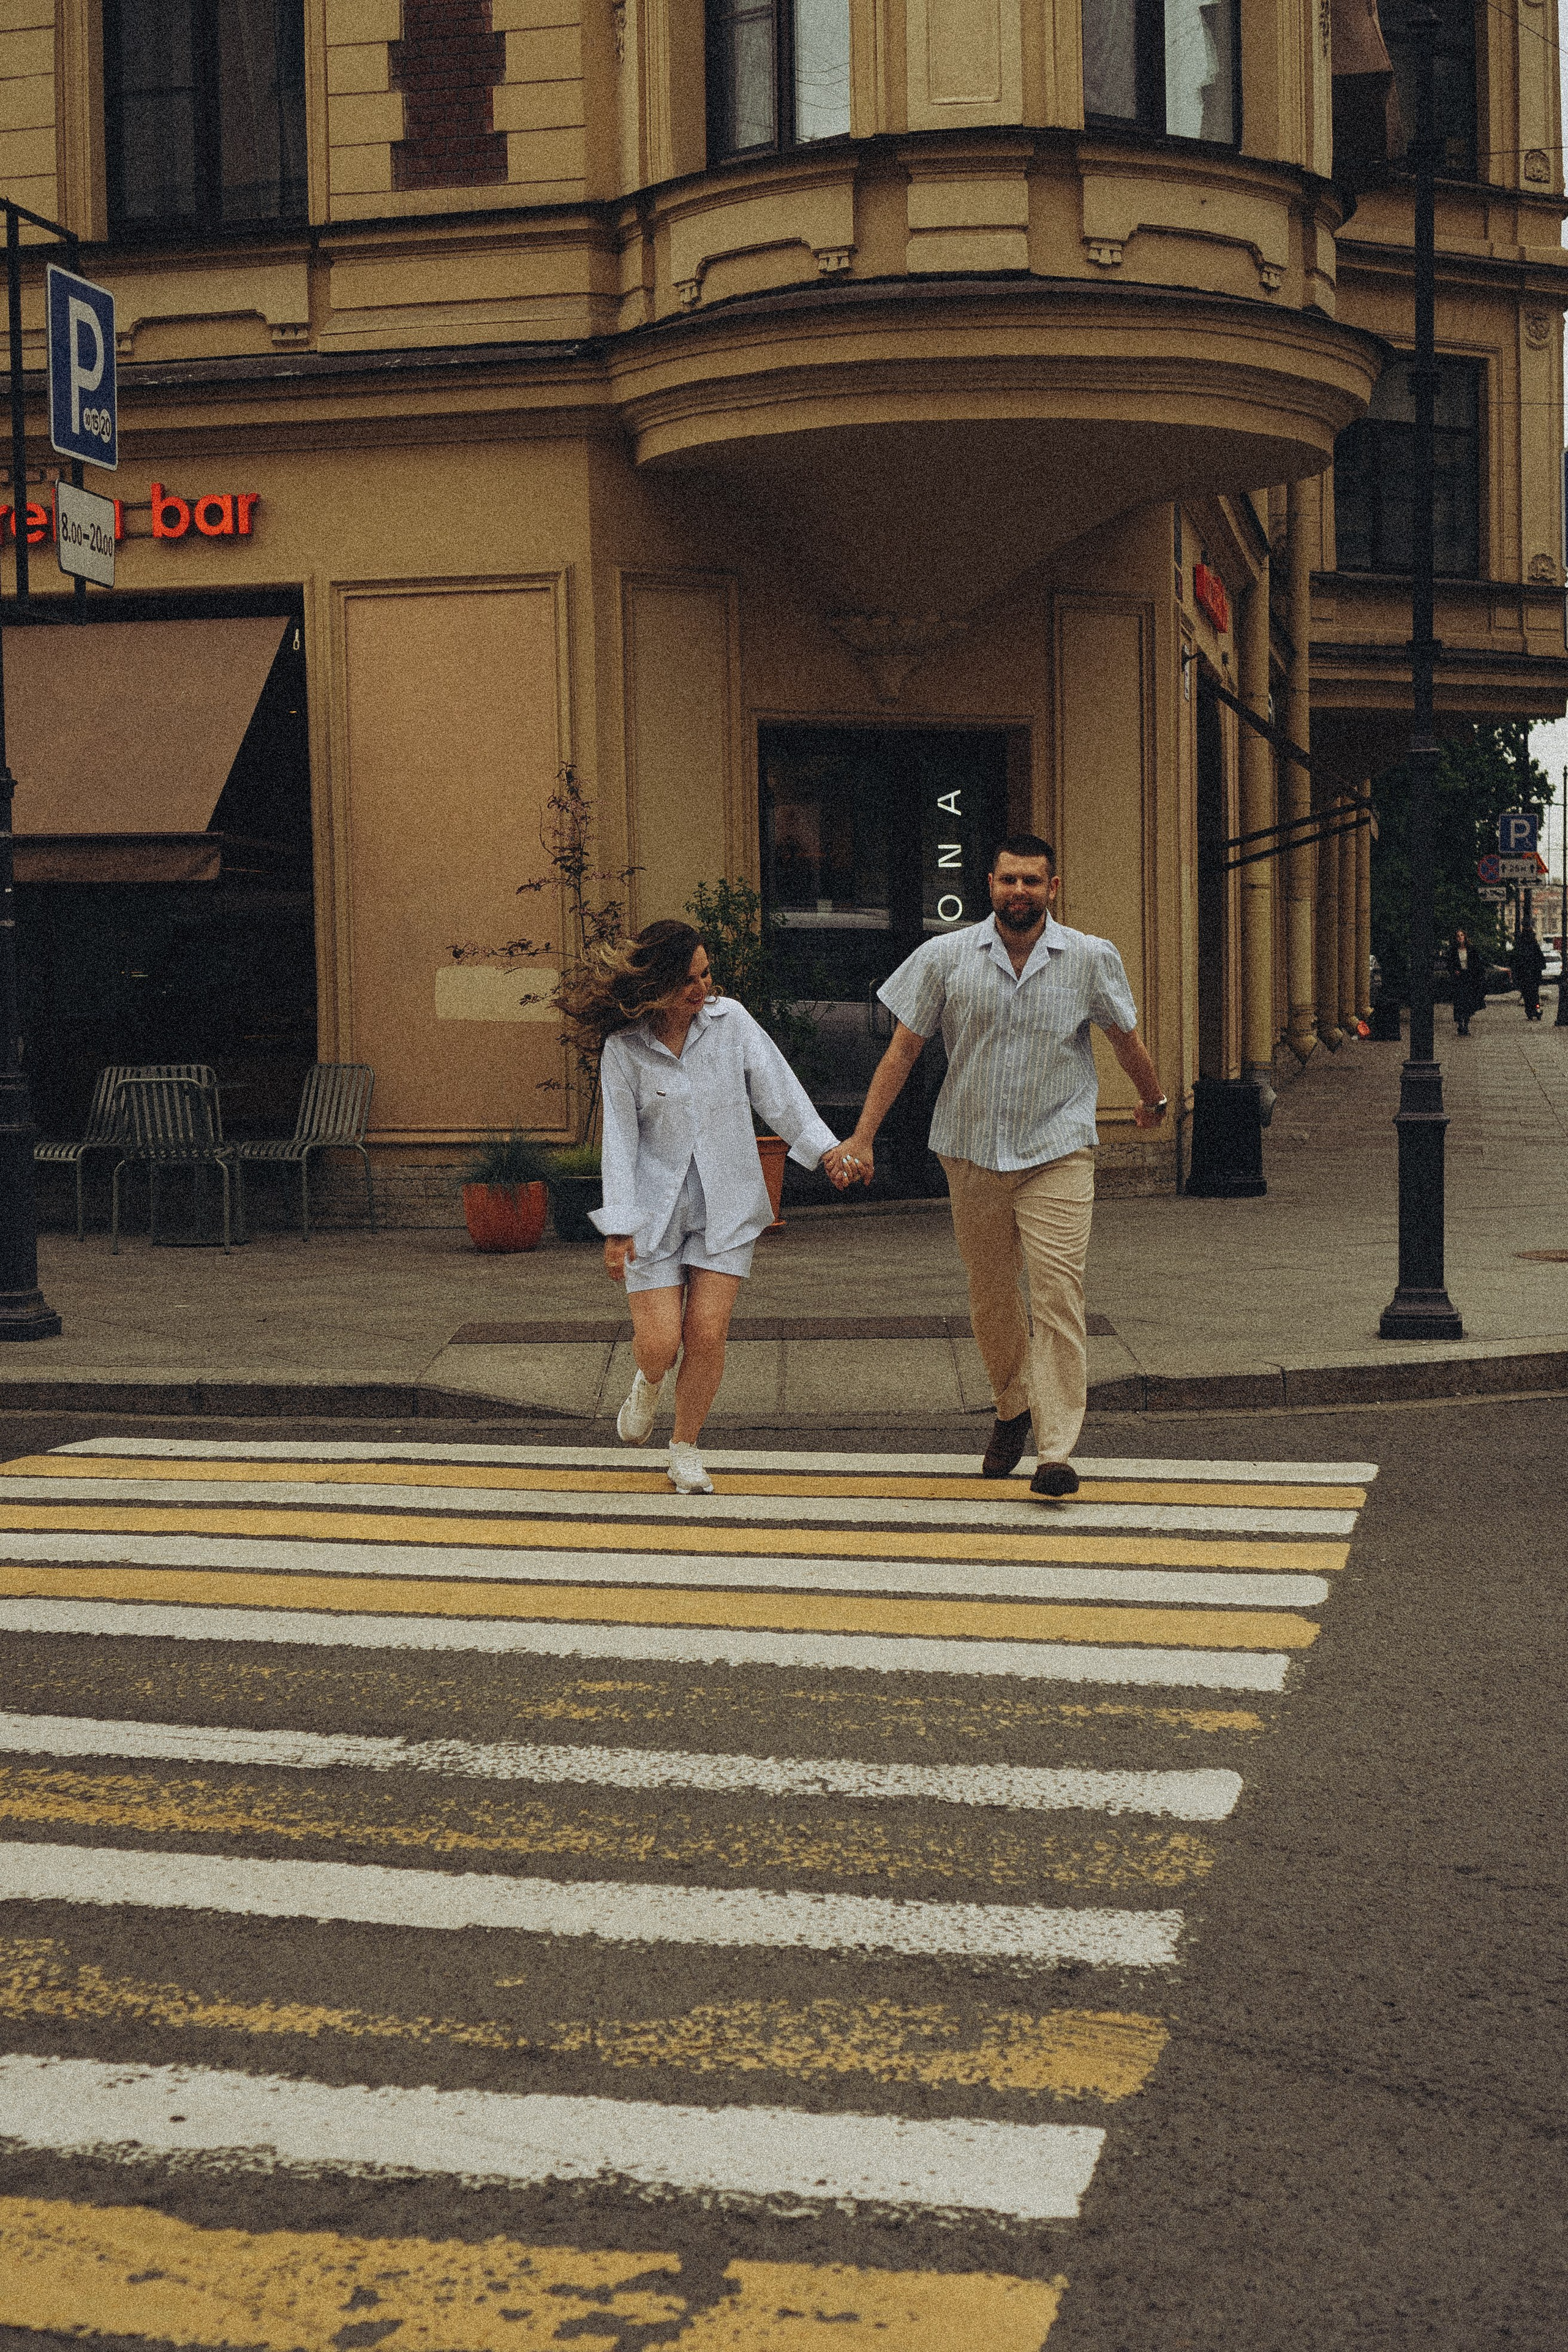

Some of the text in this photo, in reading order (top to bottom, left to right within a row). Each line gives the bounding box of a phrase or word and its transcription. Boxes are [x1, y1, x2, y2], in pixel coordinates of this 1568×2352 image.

[69, 296, 104, 434] P
[92, 414, 99, 431] 15
[101, 416, 110, 437] 20
[151, 483, 260, 538] bar
[1510, 819, 1531, 848] P
